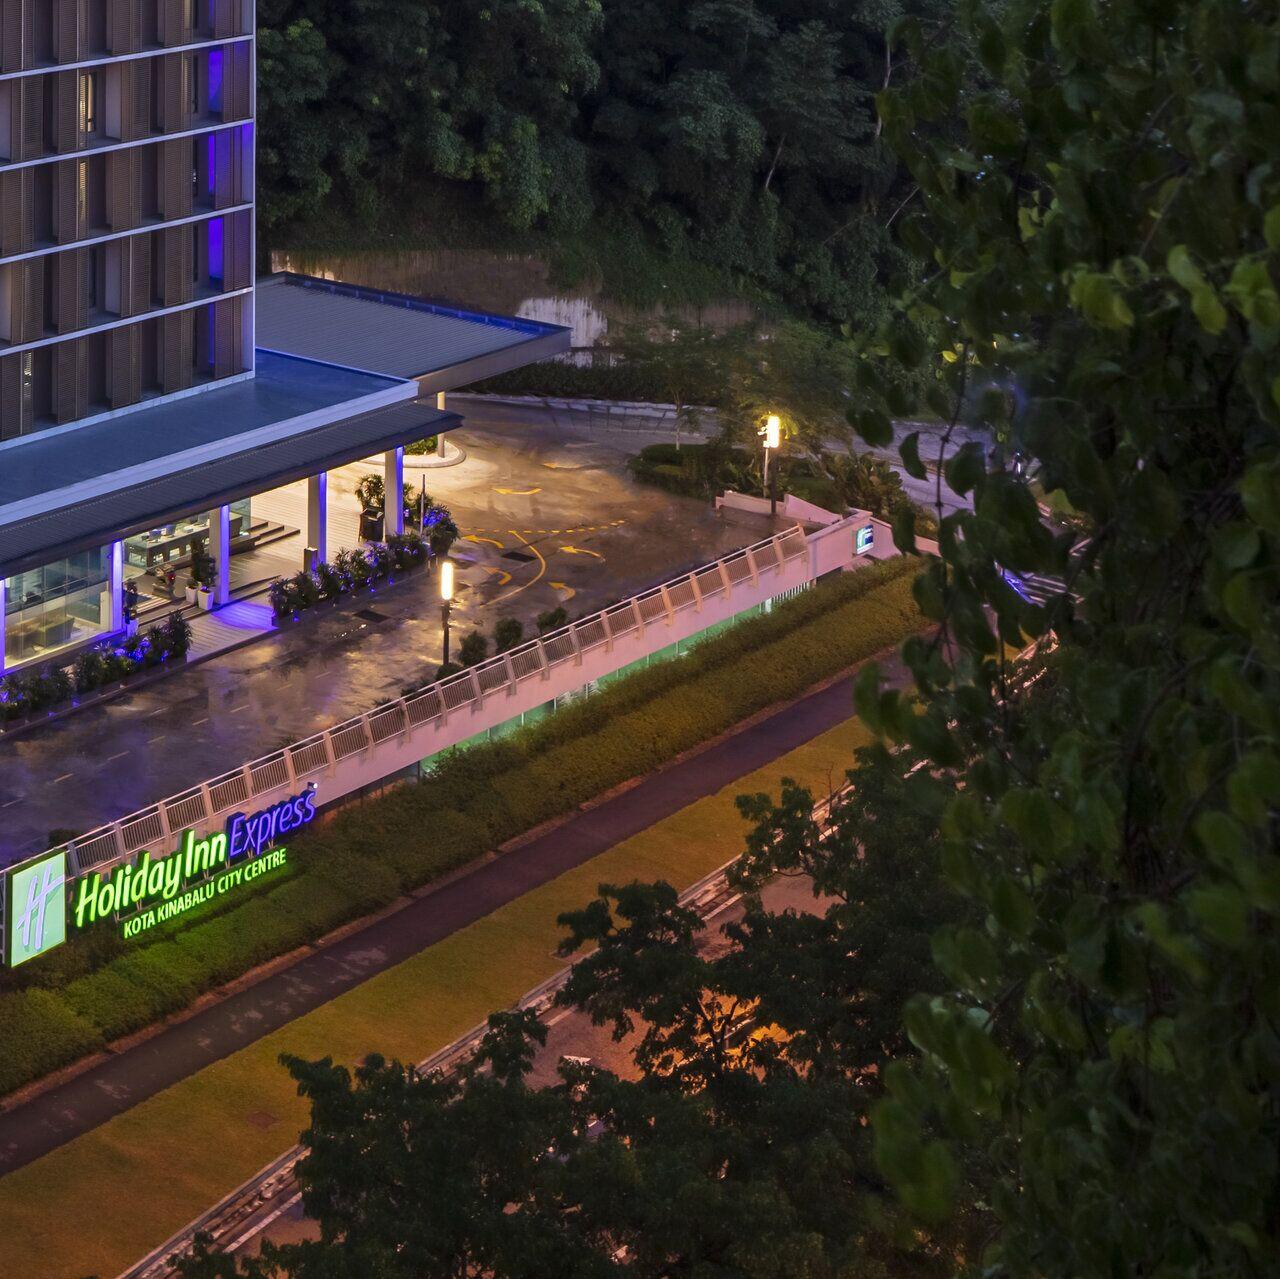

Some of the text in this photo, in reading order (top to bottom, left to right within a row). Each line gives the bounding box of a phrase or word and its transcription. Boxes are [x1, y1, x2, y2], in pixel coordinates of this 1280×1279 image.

[75, 790, 316, 928] Holiday Inn Express
[123, 847, 287, 939] KOTA KINABALU CITY CENTRE
